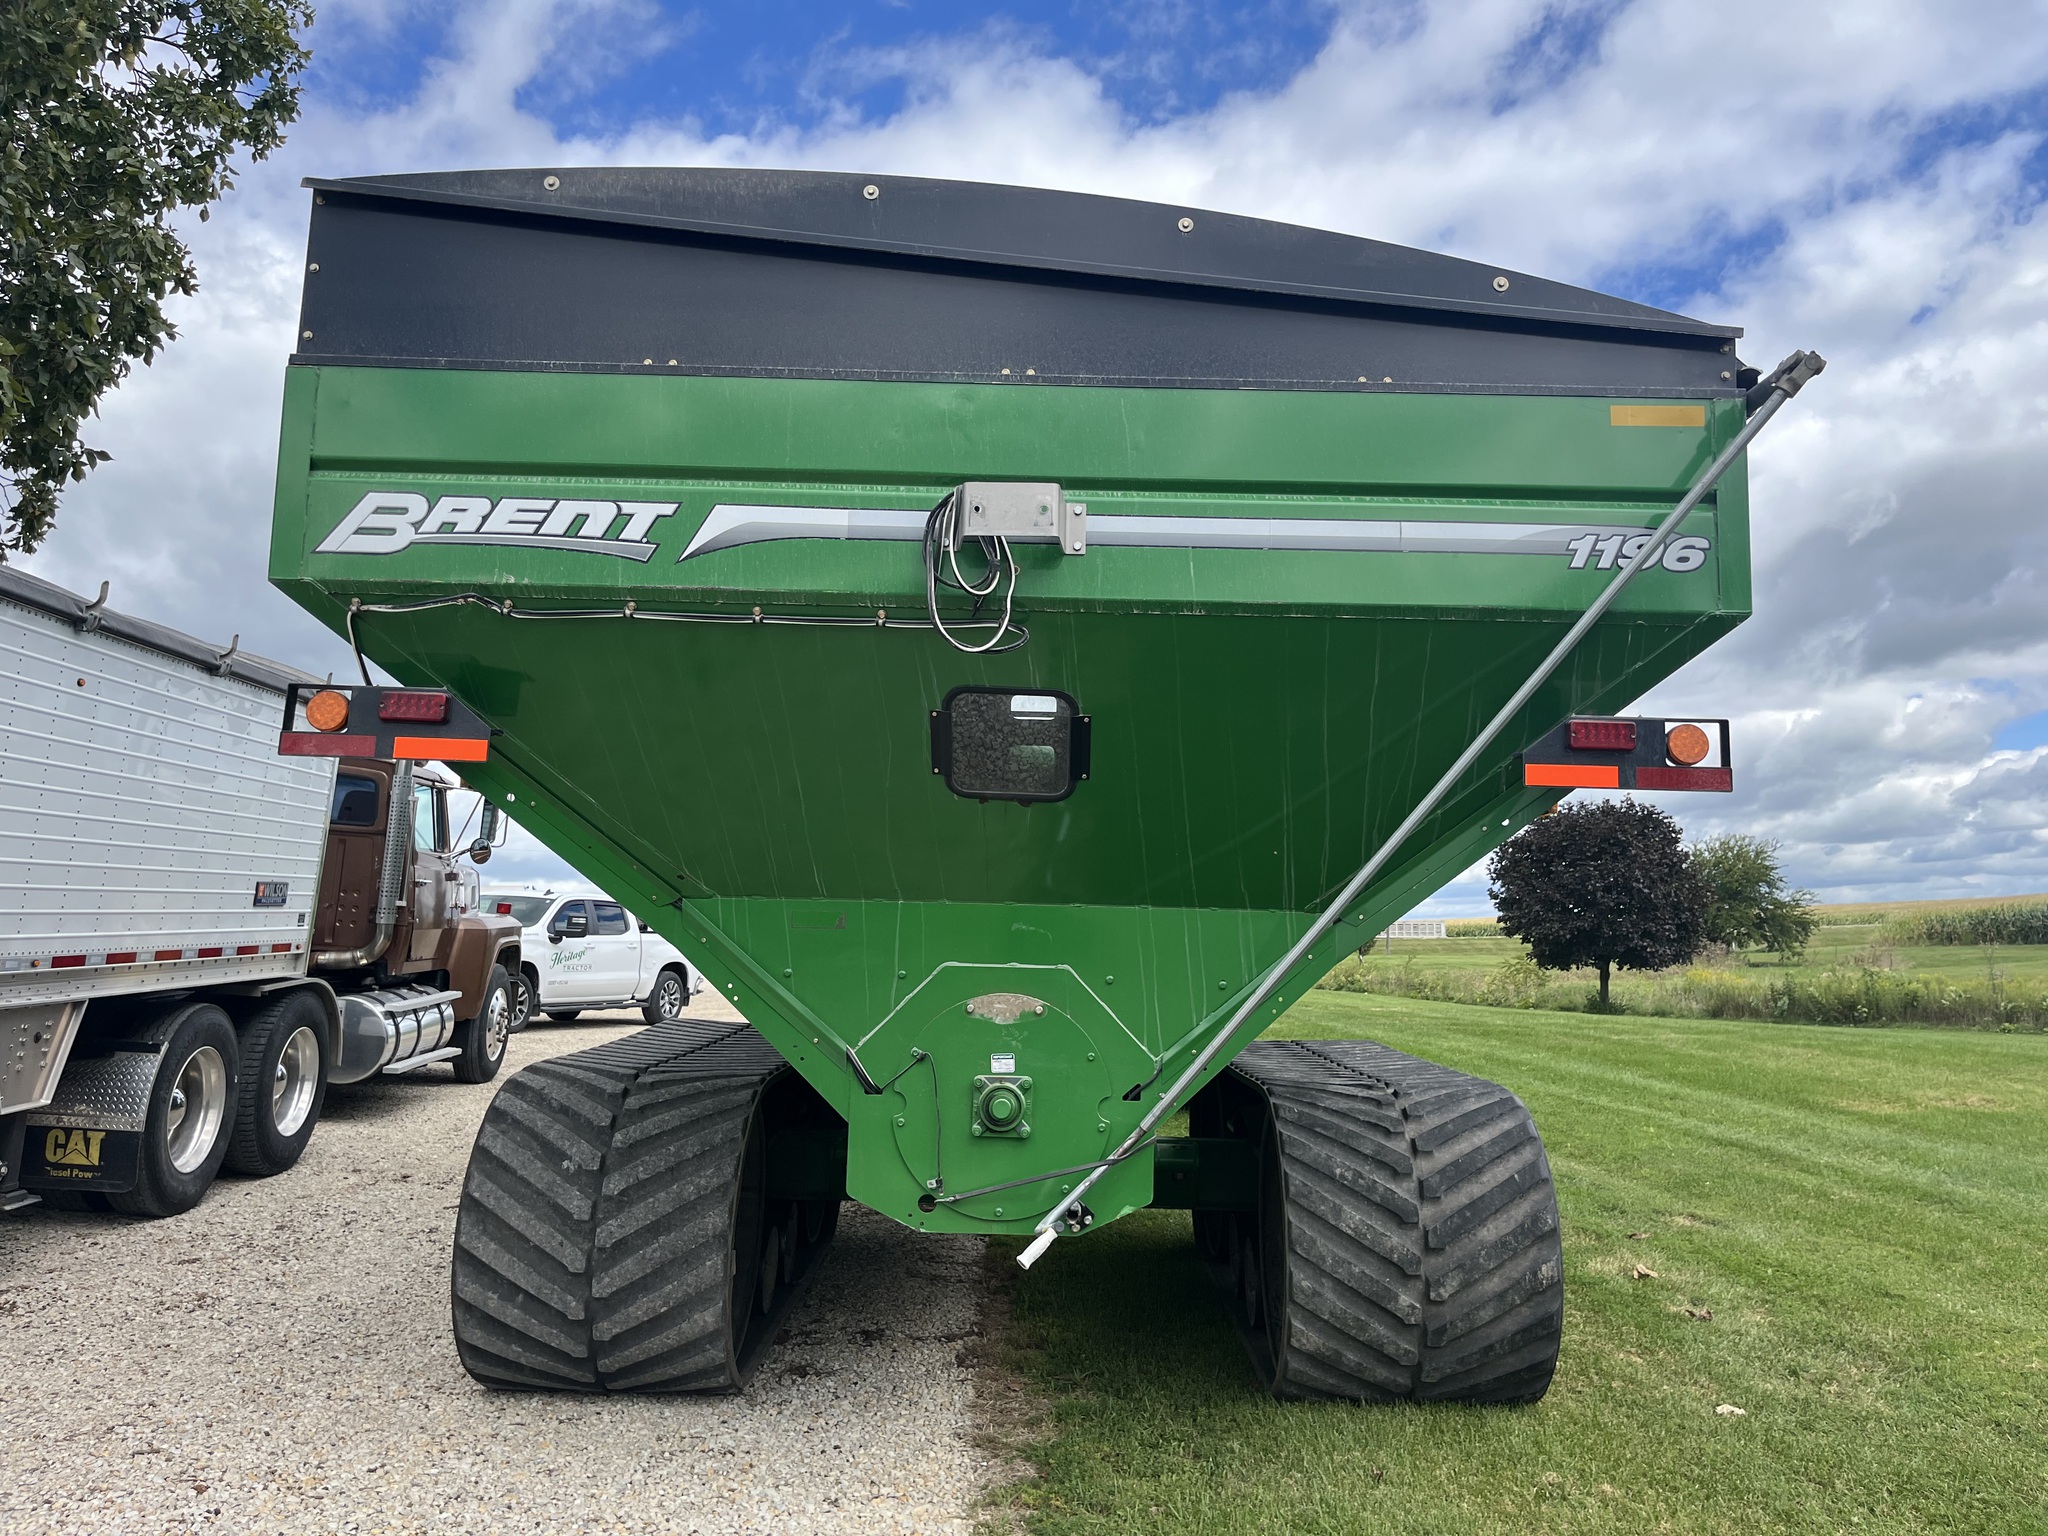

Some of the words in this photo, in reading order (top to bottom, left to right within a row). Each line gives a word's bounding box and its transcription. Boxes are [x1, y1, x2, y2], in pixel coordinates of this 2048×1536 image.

[312, 491, 681, 554] BRENT
[1566, 534, 1711, 573] 1196
[549, 949, 586, 969] Heritage
[45, 1128, 106, 1166] CAT
[44, 1166, 70, 1177] iesel
